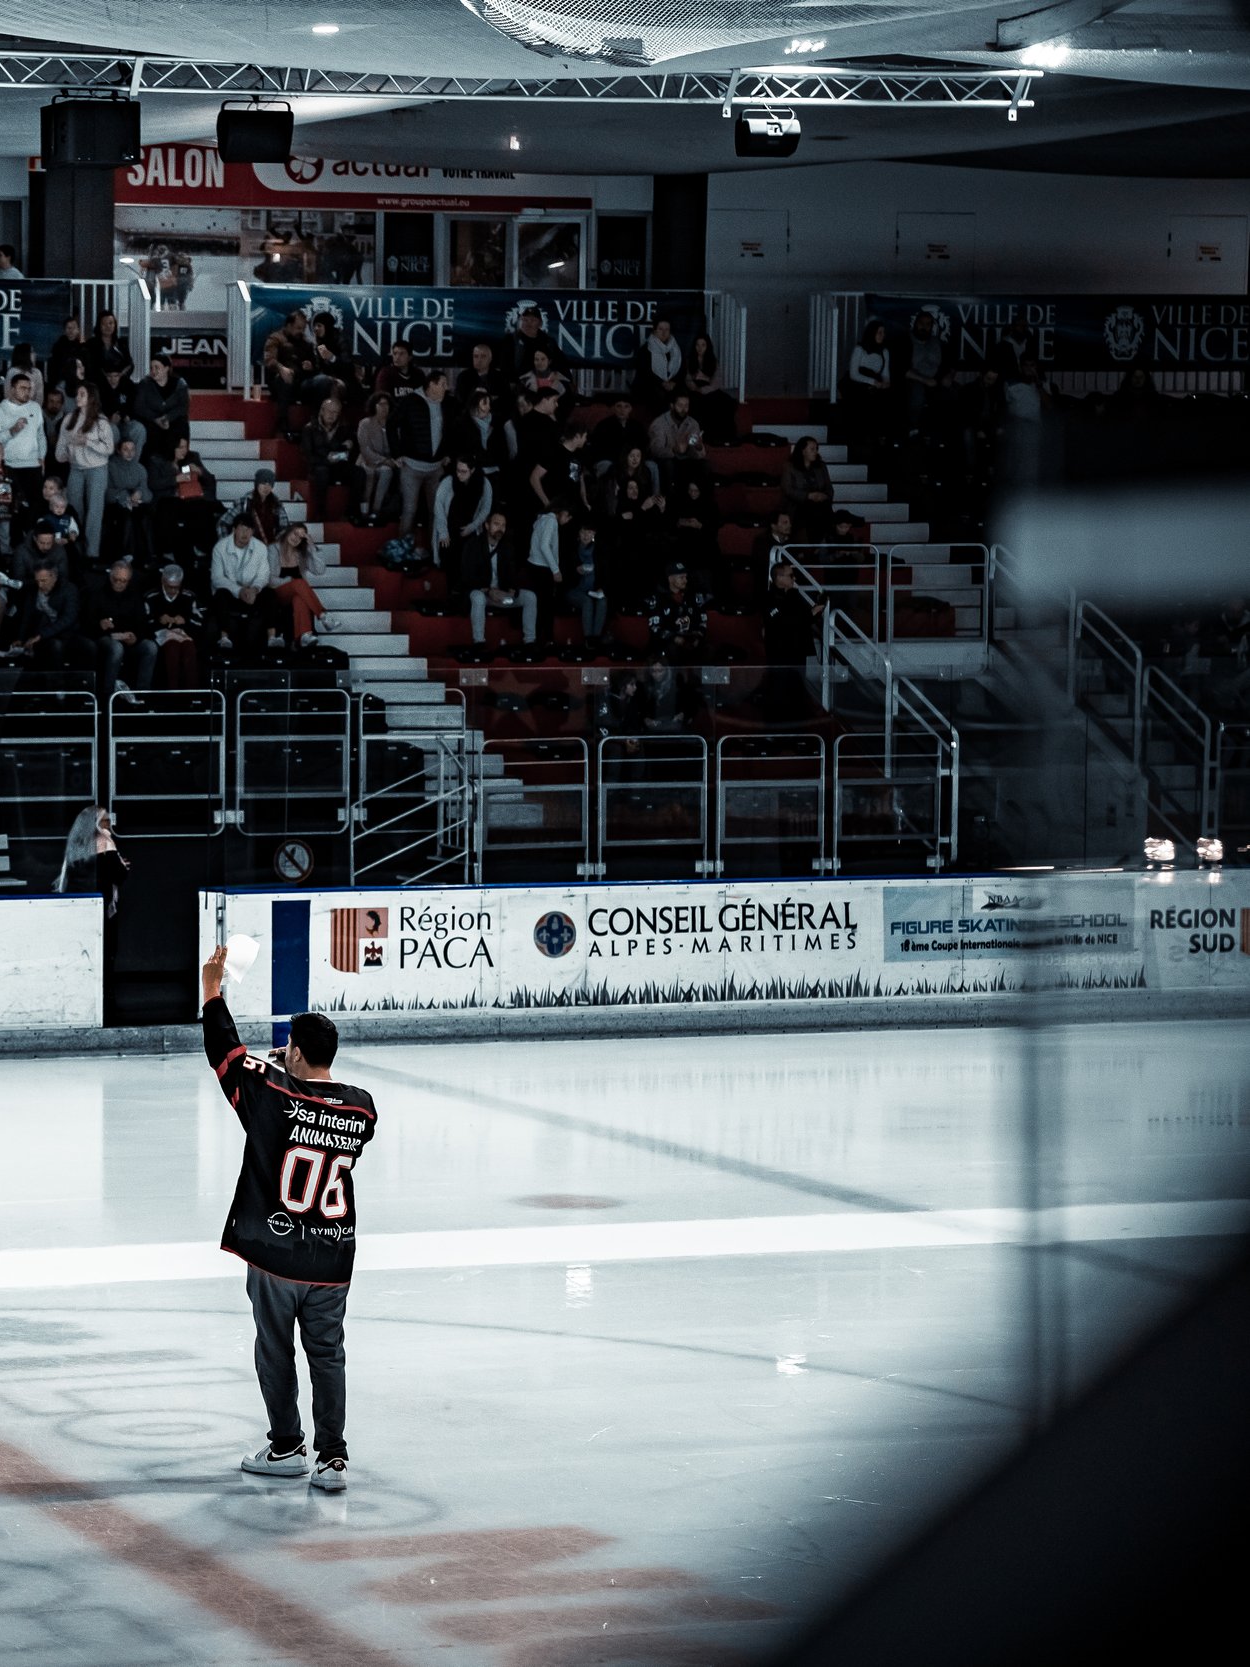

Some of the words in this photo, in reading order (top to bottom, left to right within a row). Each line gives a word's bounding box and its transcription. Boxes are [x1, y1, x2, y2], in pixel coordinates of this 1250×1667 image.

[126, 147, 225, 188] SALON
[350, 297, 415, 319] VILLE
[422, 298, 455, 320] DE
[554, 299, 618, 322] VILLE
[626, 300, 658, 322] DE
[958, 304, 1020, 325] VILLE
[1026, 304, 1056, 325] DE
[1151, 304, 1214, 326] VILLE
[1220, 304, 1250, 326] DE
[161, 338, 228, 355] JEAN
[351, 319, 455, 357] NICE
[957, 326, 1055, 361] NE
[1153, 327, 1250, 361] NICE
[400, 905, 491, 940] Région
[588, 905, 713, 937] CONSEIL
[718, 897, 857, 933] GÉNÉRAL
[890, 919, 953, 936] FIGURE
[958, 916, 1054, 934] SKATIN
[1058, 913, 1128, 928] SCHOOL
[1150, 905, 1235, 929] RÉGION
[400, 936, 494, 969] PACA
[931, 940, 958, 952] Coupe
[960, 938, 1021, 950] Internationale
[1065, 934, 1083, 945] Ville
[1085, 934, 1095, 944] de
[1097, 933, 1118, 944] NICE
[1189, 933, 1235, 954] SUD
[289, 1125, 361, 1151] ANIMATEUR
[280, 1145, 354, 1220] 06
[267, 1218, 295, 1229] NISSAN
